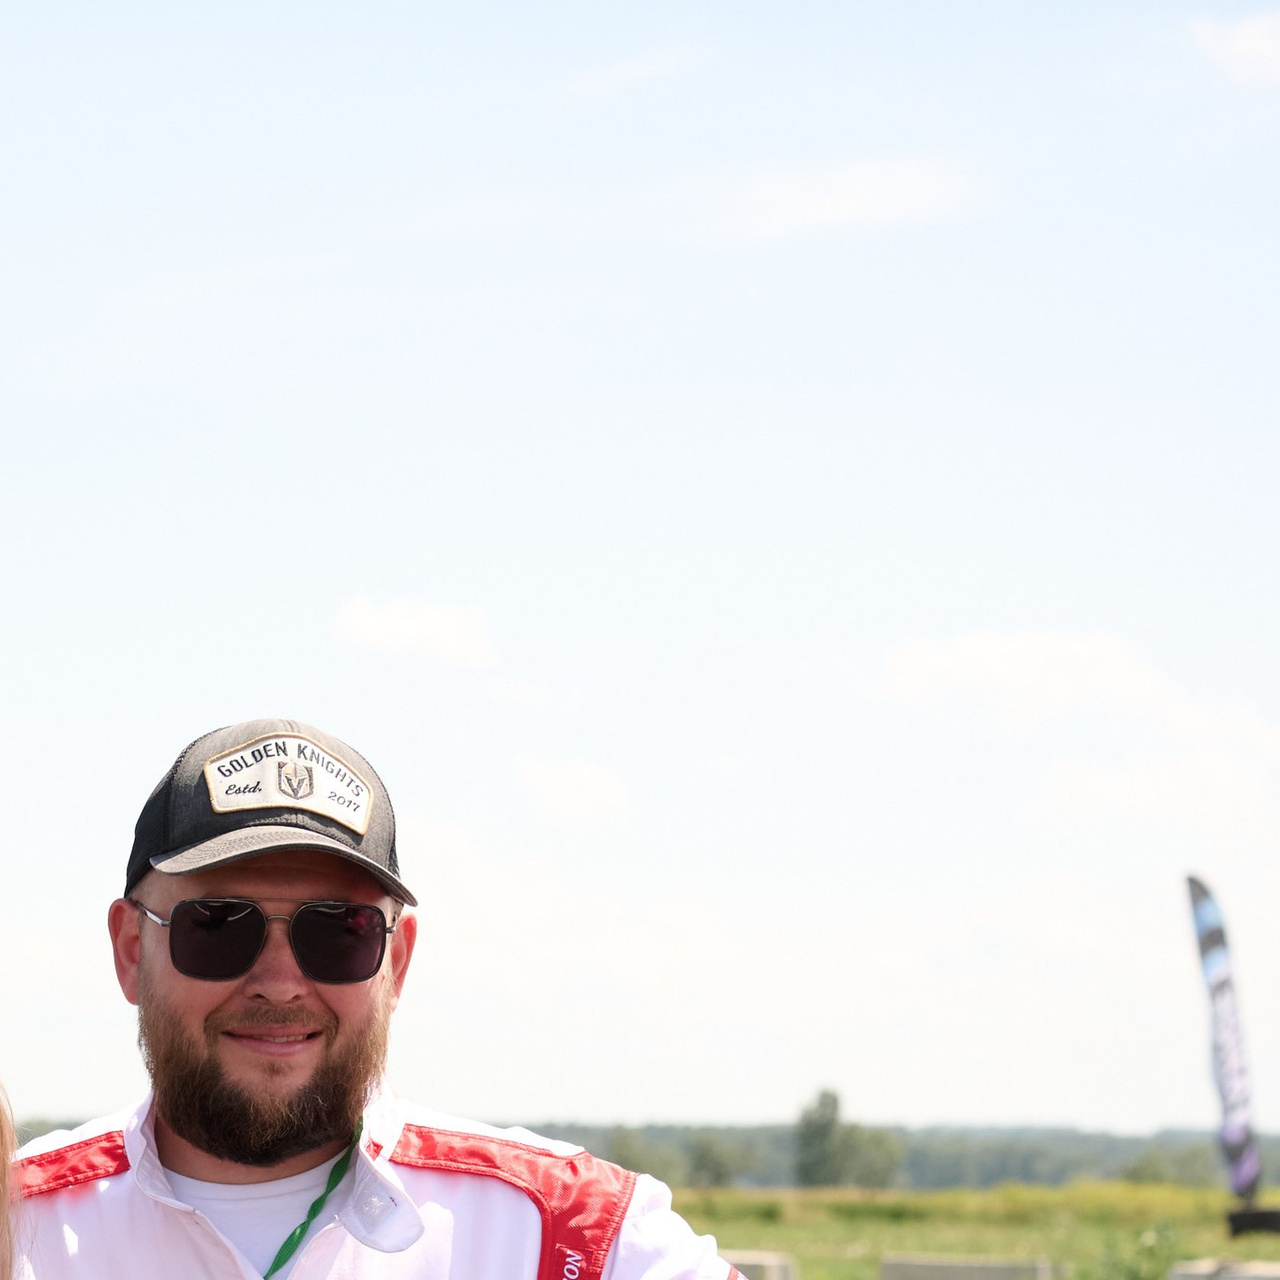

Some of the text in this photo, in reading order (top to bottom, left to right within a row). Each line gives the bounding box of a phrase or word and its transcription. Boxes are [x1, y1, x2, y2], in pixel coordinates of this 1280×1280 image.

[217, 741, 364, 798] GOLDEN KNIGHTS
[224, 780, 263, 796] Estd.
[327, 791, 361, 813] 2017
